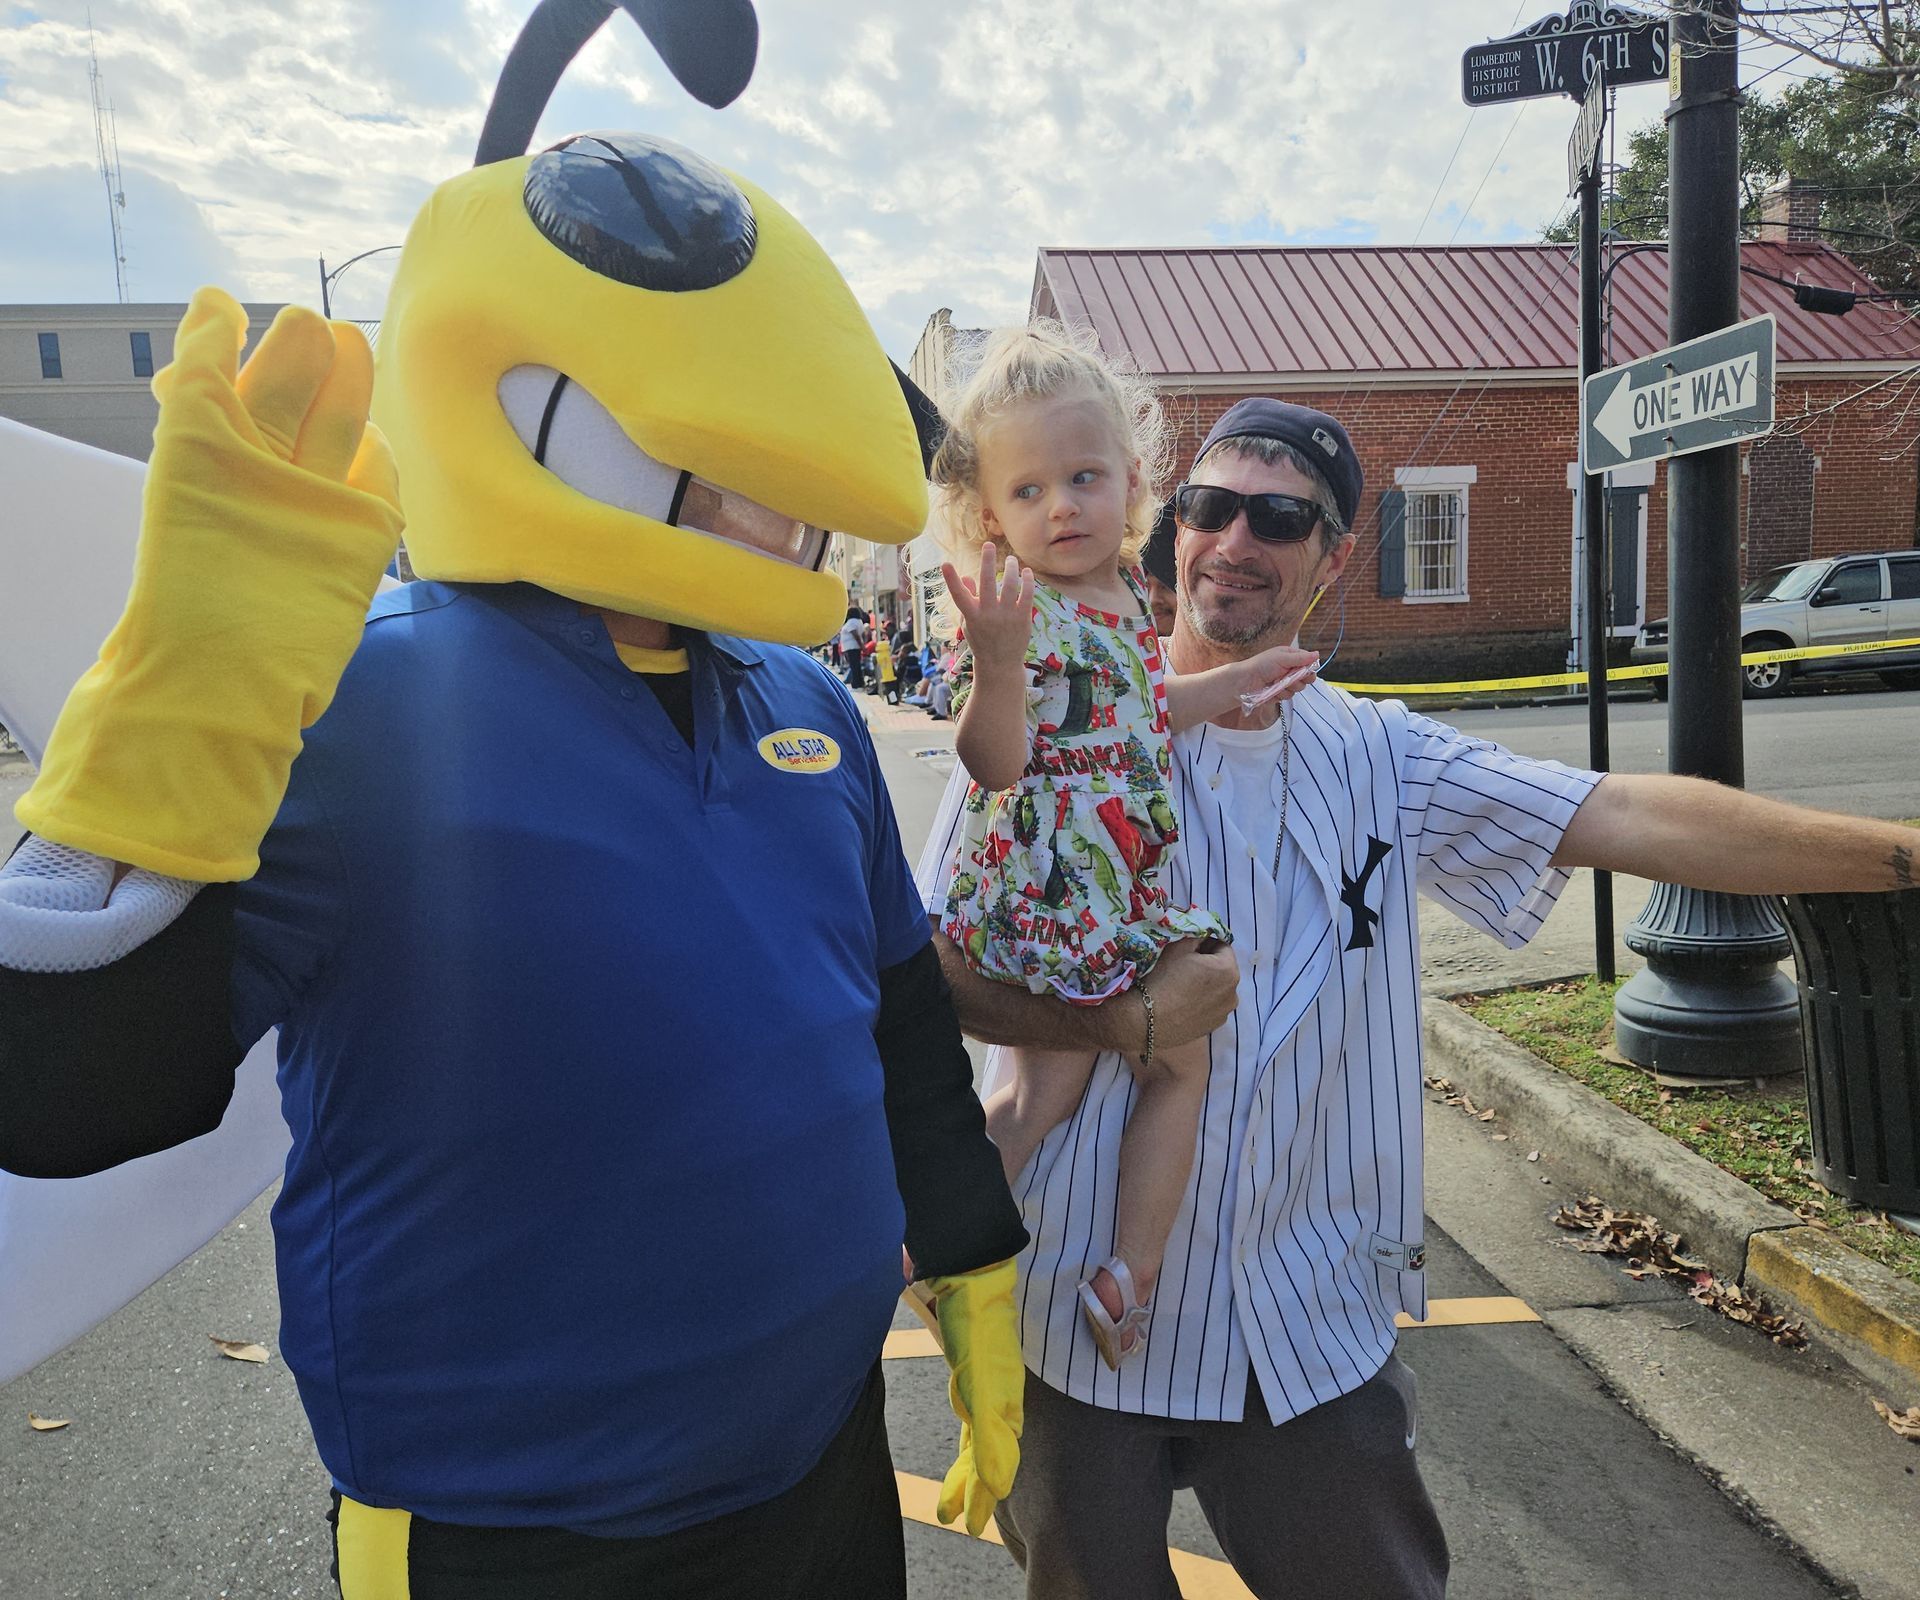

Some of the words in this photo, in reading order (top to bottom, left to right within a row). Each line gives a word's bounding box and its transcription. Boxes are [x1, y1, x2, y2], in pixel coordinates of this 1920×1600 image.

[1471, 51, 1520, 68] LUMBERTON
[1535, 41, 1564, 90] W.
[1582, 32, 1631, 84] 6TH
[1652, 27, 1665, 75] S
[1472, 66, 1520, 82] HISTORIC
[1472, 81, 1520, 97] DISTRICT
[1634, 382, 1681, 430] ONE
[1692, 360, 1749, 415] WAY
[772, 740, 801, 760] ALL
[797, 738, 830, 756] STAR
